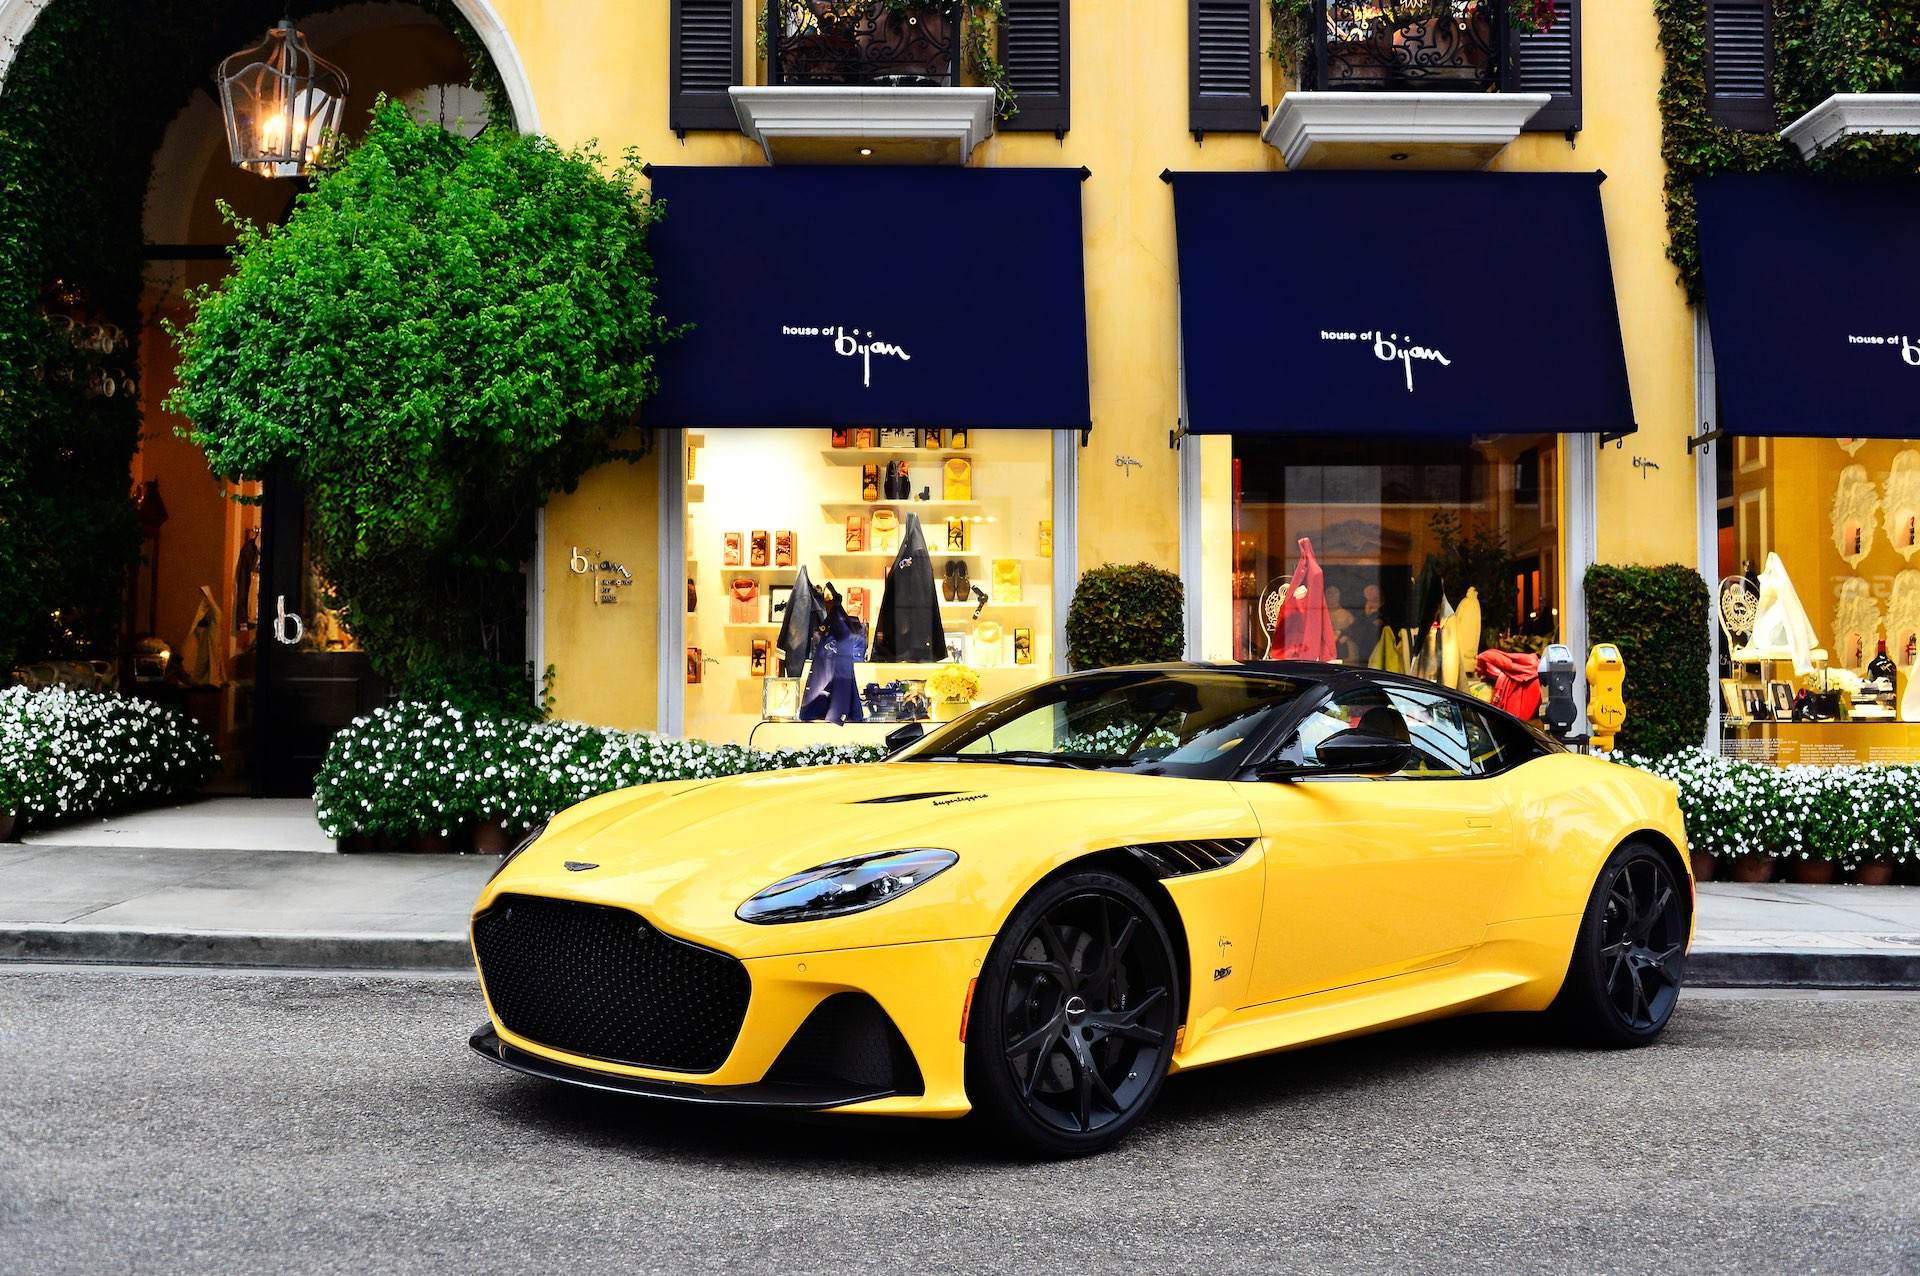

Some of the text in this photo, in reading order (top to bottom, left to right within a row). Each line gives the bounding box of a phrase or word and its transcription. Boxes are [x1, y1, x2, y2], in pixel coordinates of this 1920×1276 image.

[783, 325, 911, 387] house of bijan
[1848, 335, 1884, 344] house
[1887, 335, 1899, 344] of
[1321, 330, 1451, 392] house of bijan
[1115, 455, 1143, 477] bijan
[1633, 456, 1660, 479] bijan
[570, 546, 632, 605] bijan
[274, 595, 303, 645] b
[1601, 704, 1622, 725] bijan
